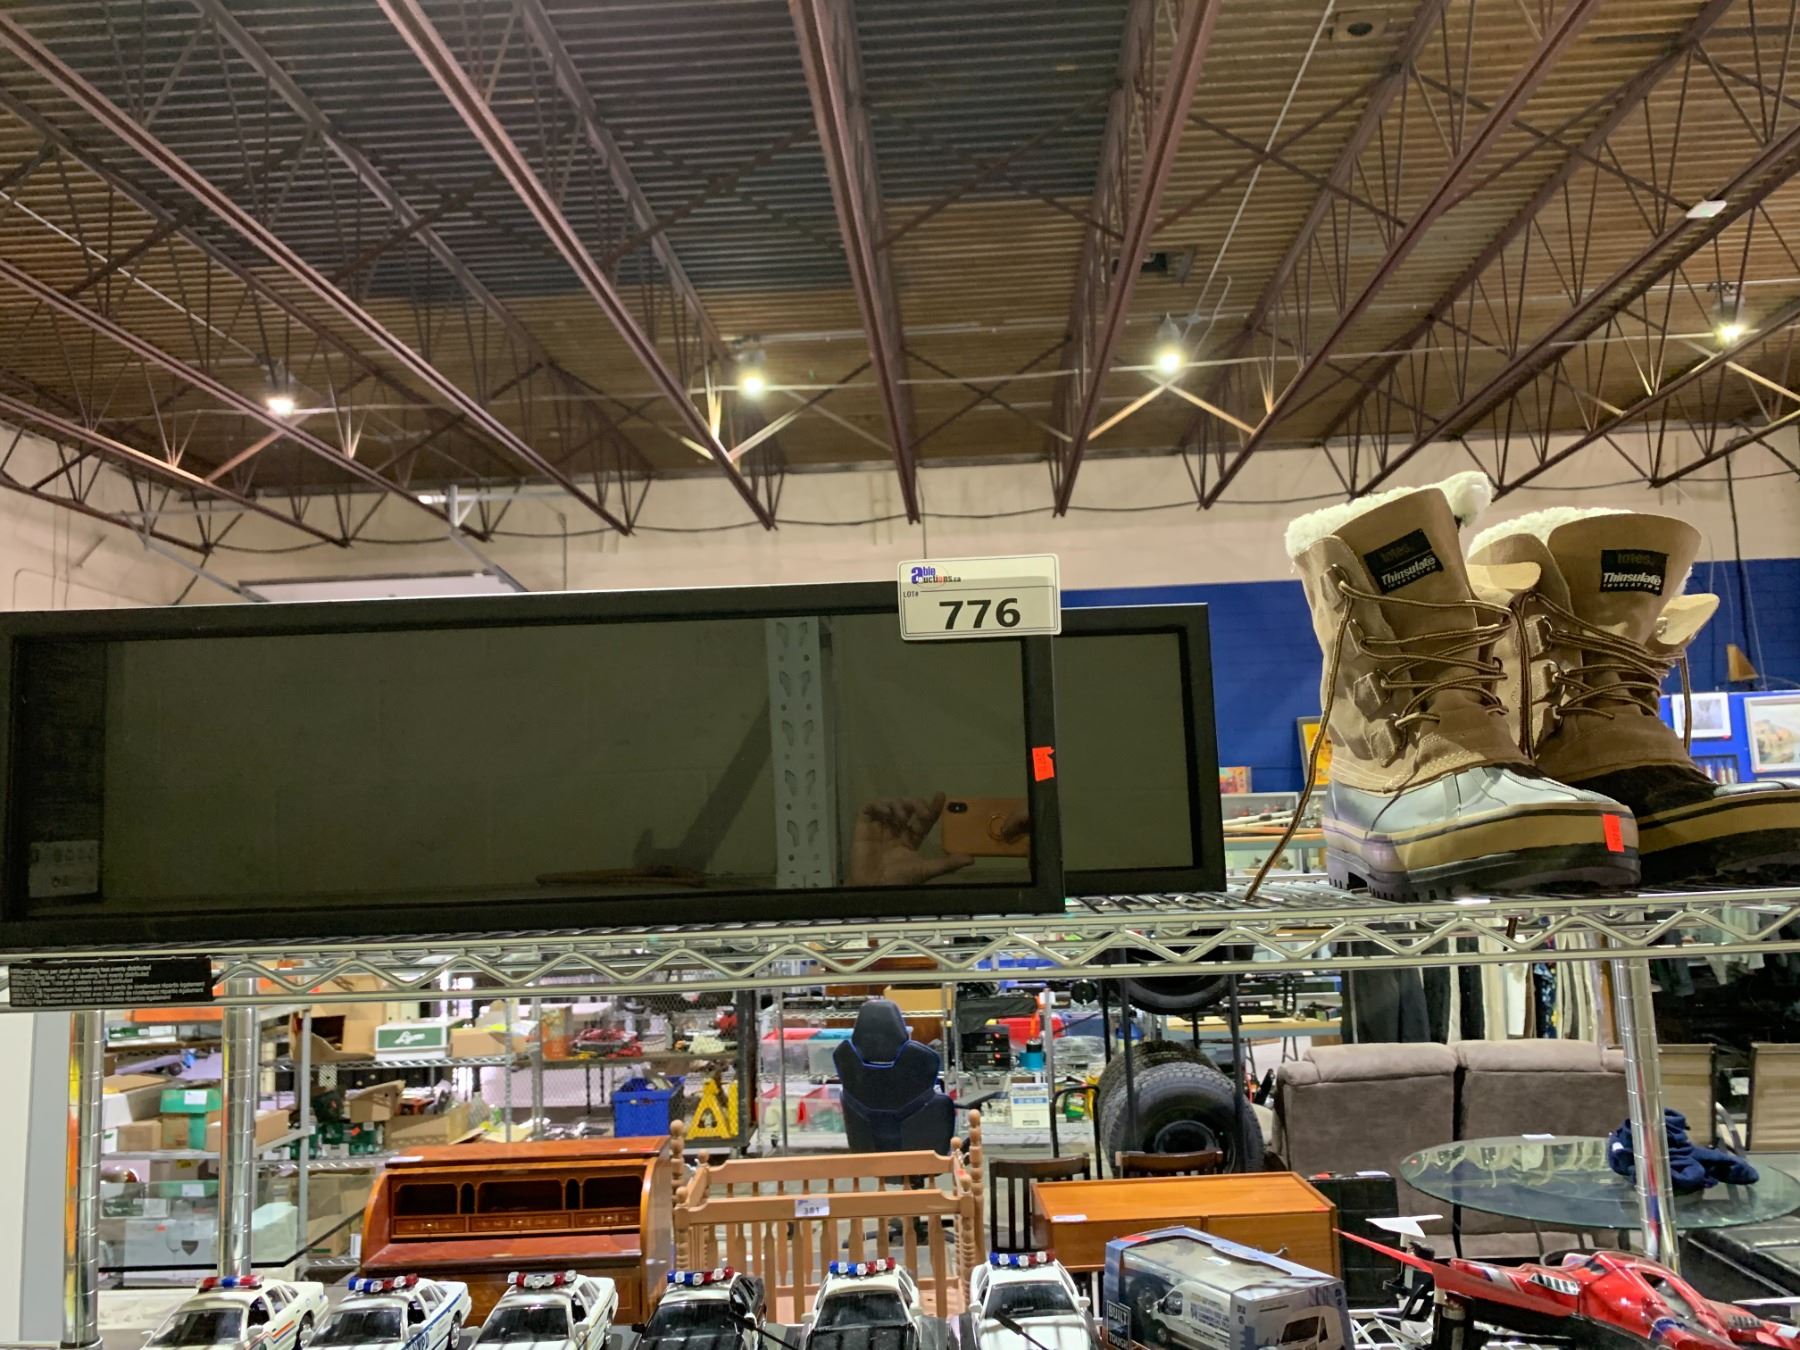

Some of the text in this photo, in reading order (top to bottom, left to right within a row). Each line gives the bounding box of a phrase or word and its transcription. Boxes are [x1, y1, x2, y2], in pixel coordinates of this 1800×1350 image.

[1381, 554, 1436, 586] Thinsulate
[1603, 571, 1662, 586] Thinsulate
[939, 597, 1021, 630] 776
[1109, 1304, 1128, 1325] BUILT
